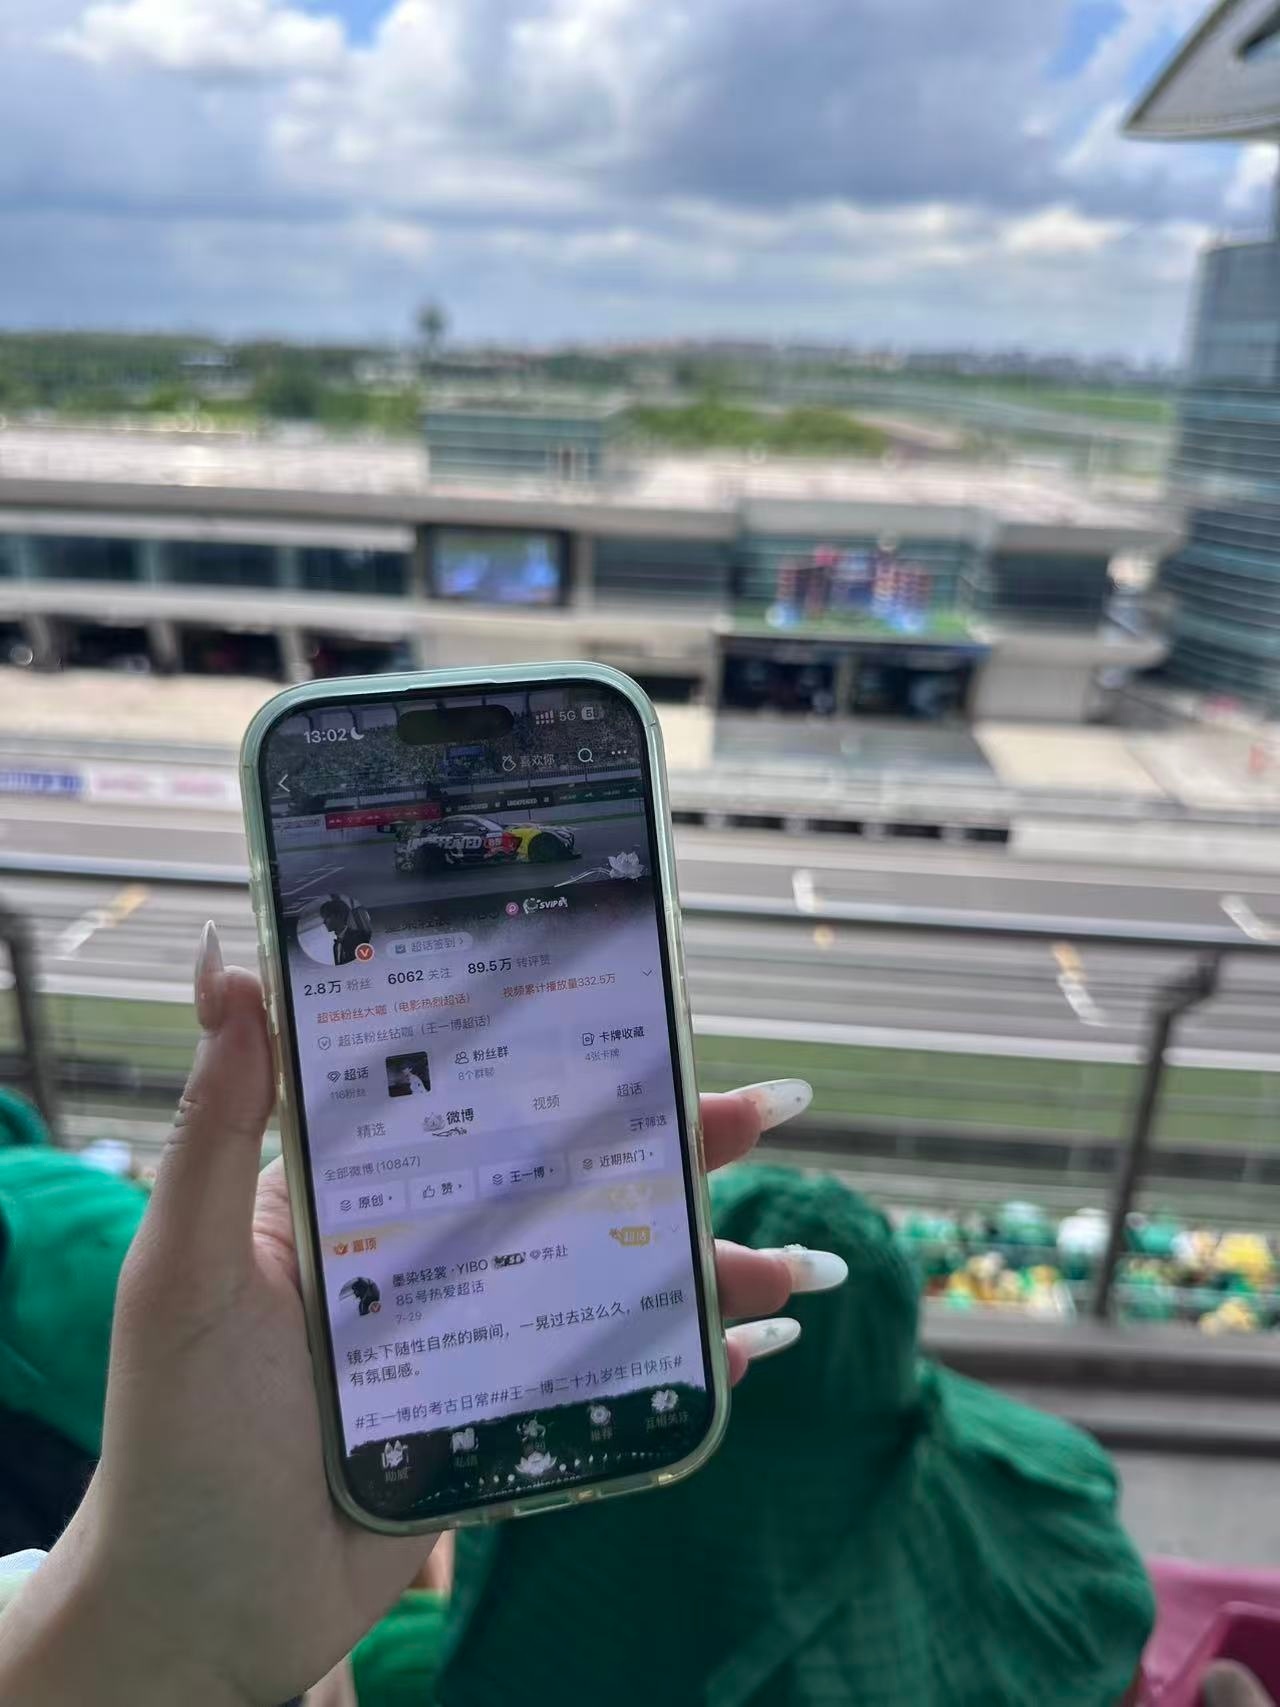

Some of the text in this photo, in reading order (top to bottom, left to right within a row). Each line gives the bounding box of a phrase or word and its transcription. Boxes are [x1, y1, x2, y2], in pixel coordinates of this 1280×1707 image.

[558, 709, 577, 722] 5G
[304, 727, 348, 746] 13:02
[468, 953, 551, 976] 89.5万 转评赞
[387, 966, 453, 986] 6062 关注
[304, 979, 342, 998] 2.8万
[502, 972, 616, 1000] 视频累计播放量332.5万
[598, 1025, 646, 1044] 卡牌收藏
[472, 1046, 511, 1063] 粉丝群
[343, 1065, 370, 1082] 超话
[616, 1081, 644, 1098] 超话
[532, 1094, 561, 1111] 视频
[446, 1107, 475, 1124] 微博
[356, 1122, 387, 1140] 精选
[598, 1149, 646, 1168] 近期热门
[509, 1166, 546, 1184] 王一博
[440, 1181, 454, 1196] 赞
[357, 1193, 385, 1210] 原创
[395, 1280, 485, 1308] 85号热爱超话
[349, 1363, 422, 1386] 有氛围感。
